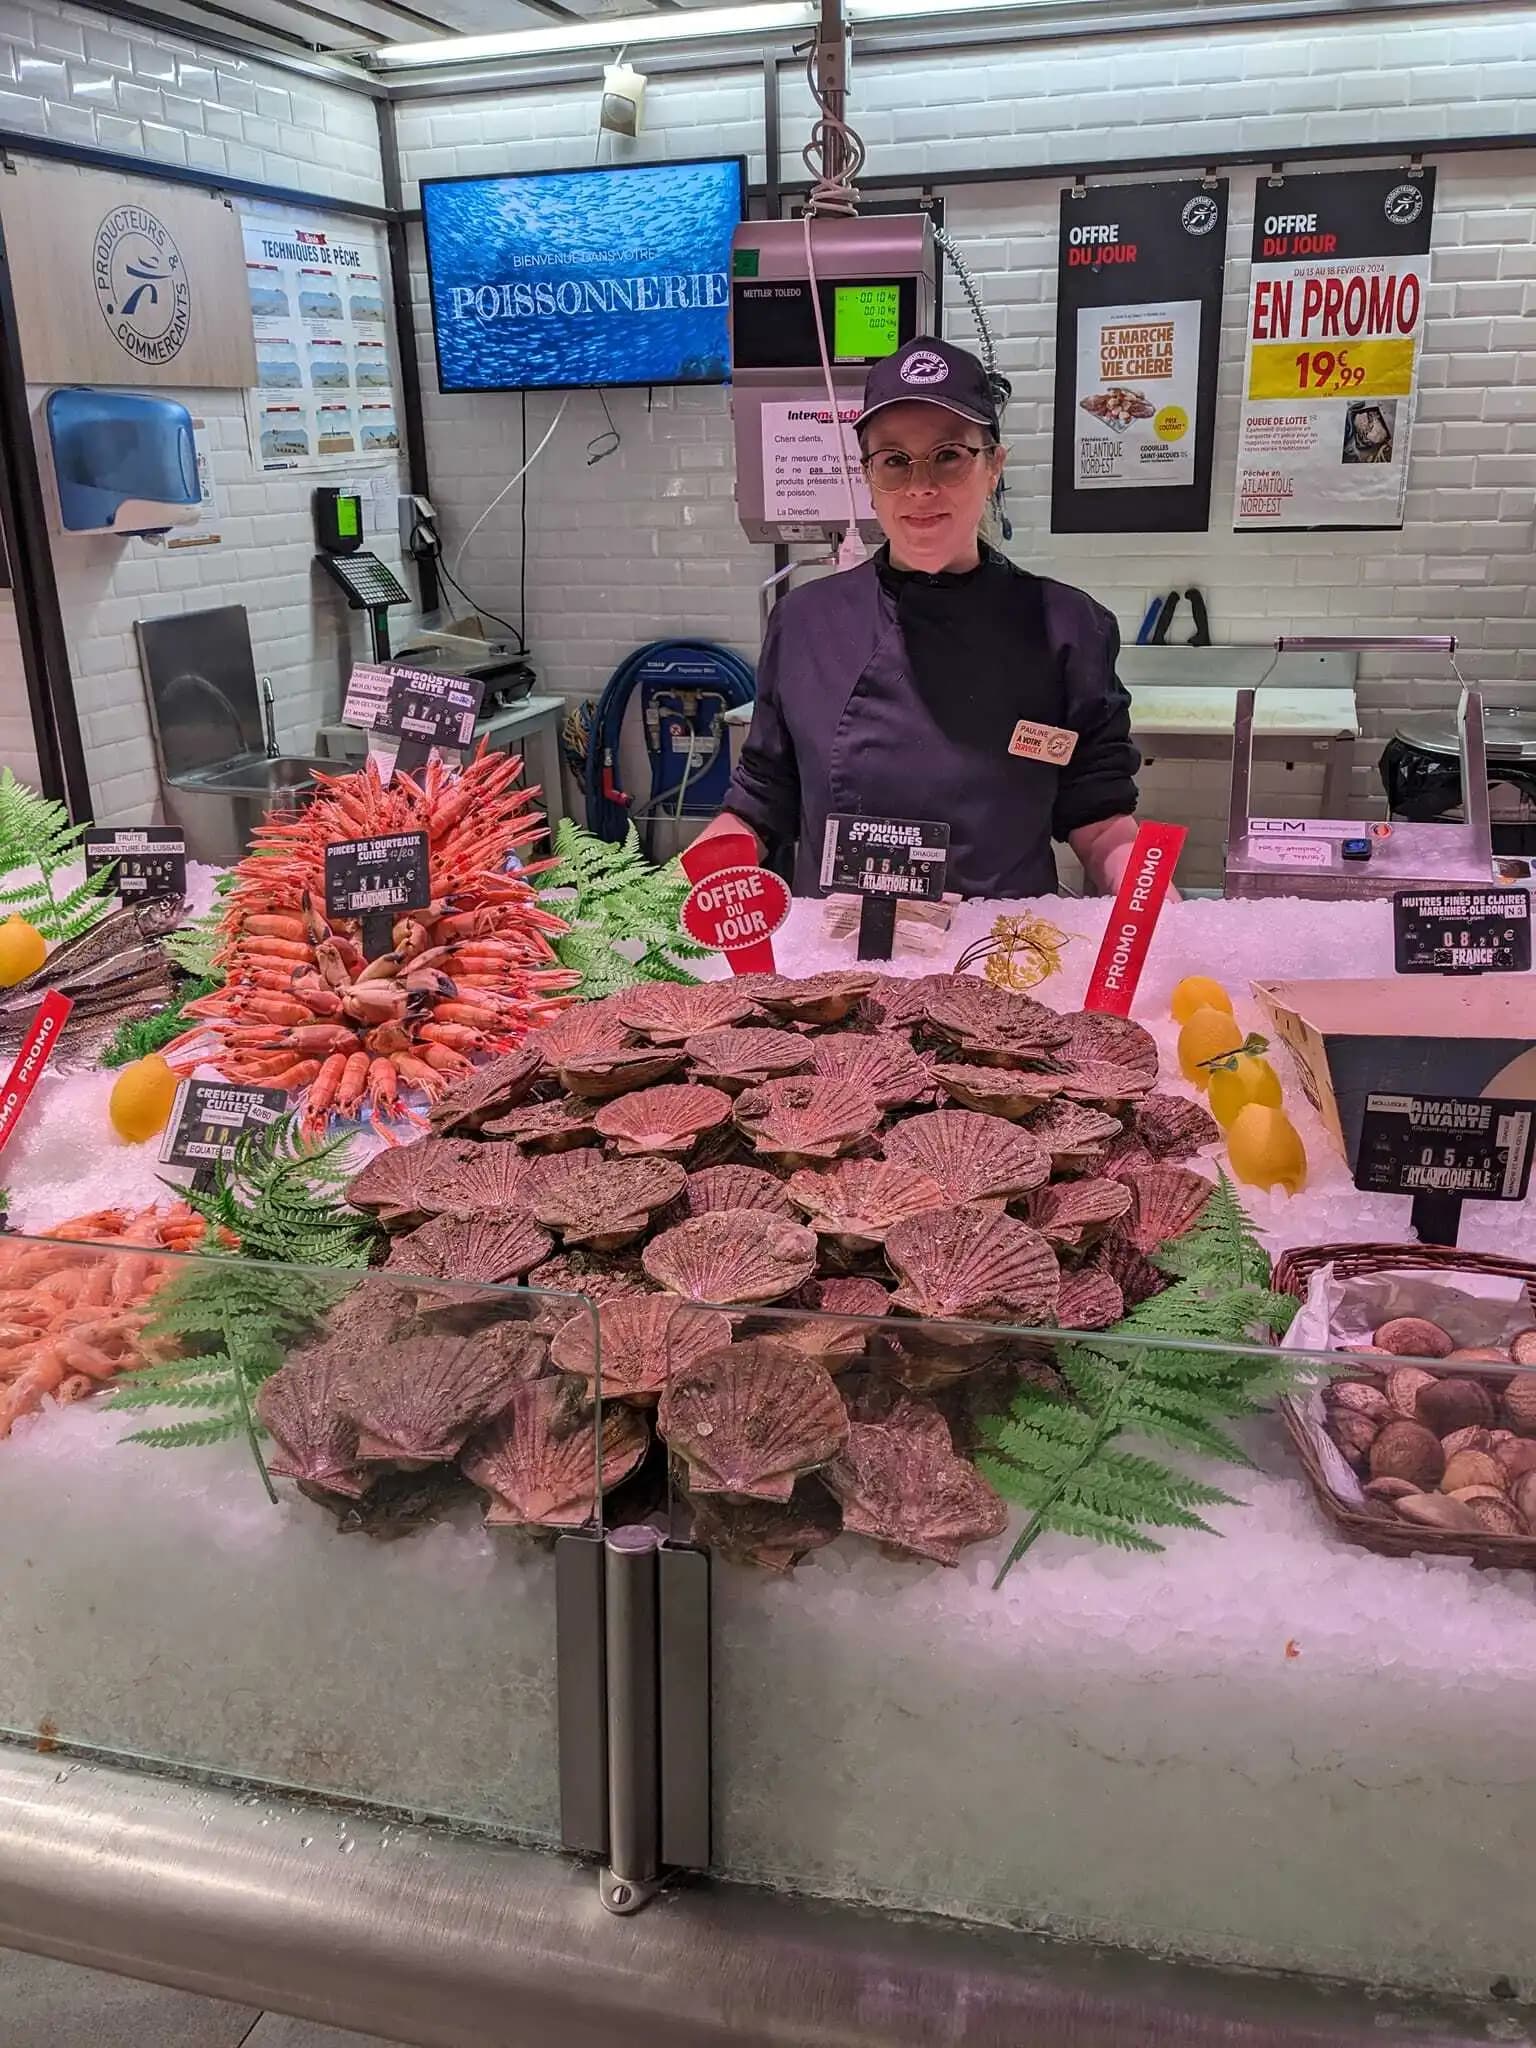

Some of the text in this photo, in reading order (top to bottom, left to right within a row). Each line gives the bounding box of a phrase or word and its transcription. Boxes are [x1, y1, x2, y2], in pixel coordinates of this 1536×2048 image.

[1265, 214, 1317, 234] OFFRE
[1069, 224, 1119, 245] OFFRE
[97, 210, 179, 291] PRODUCTEURS &
[1263, 233, 1338, 257] DU JOUR
[262, 240, 361, 268] TECHNIQUES DE PÊCHE
[513, 250, 578, 268] BIENVENUE
[1068, 245, 1138, 266] DU JOUR
[448, 272, 730, 321] POISSONNERIE
[743, 288, 802, 298] METTLER TOLEDO
[1253, 273, 1420, 339] EN PROMO
[117, 282, 187, 360] COMMERÇANTS
[1101, 331, 1116, 346] LE
[1101, 342, 1174, 361] CONTRE LA
[1101, 361, 1124, 377] VIE
[1247, 416, 1308, 426] QUEUE DE LOTTE
[774, 435, 796, 444] Chers
[1081, 441, 1122, 458] ATLANTIQUE
[775, 455, 788, 463] Par
[776, 465, 785, 473] de
[809, 467, 824, 475] pas
[776, 477, 804, 486] produits
[1241, 478, 1293, 494] ATLANTIQUE
[776, 489, 817, 498] de poisson.
[788, 507, 820, 516] Direction
[1240, 498, 1281, 512] NORD-EST
[390, 667, 471, 692] LANGOUSTINE
[410, 680, 446, 695] CUITE
[1020, 725, 1049, 738] PAULINE
[1023, 736, 1042, 747] VOTRE
[853, 822, 921, 837] COQUILLES
[1250, 821, 1305, 832] CCM
[328, 836, 421, 857] PINCES DE TOURTEAUX
[849, 832, 864, 841] ST
[866, 833, 923, 847] JACQUES
[358, 849, 387, 861] CUITES
[164, 861, 174, 871] €
[921, 862, 931, 872] €
[406, 869, 416, 880] €
[863, 874, 909, 891] ATLANTIQUE
[1129, 847, 1163, 912] PROMO
[696, 874, 765, 912] OFFRE
[1402, 894, 1526, 907] HUITRES FINES DE CLAIRES
[725, 902, 745, 918] DU
[1419, 904, 1504, 917] MARENNES-OLERON
[714, 910, 768, 944] JOUR
[1504, 929, 1515, 941] €
[1105, 924, 1138, 990] PROMO
[1452, 948, 1493, 965] FRANCE
[18, 1017, 54, 1083] PROMO
[196, 1087, 264, 1104] CREVETTES
[206, 1100, 249, 1113] CUITES
[251, 1108, 272, 1120] 40/60
[1411, 1100, 1493, 1117] AMANDE
[1409, 1113, 1491, 1129] VIVANTE
[189, 1145, 232, 1157] EQUATEUR
[1407, 1167, 1471, 1187] ATLANTIQUE
